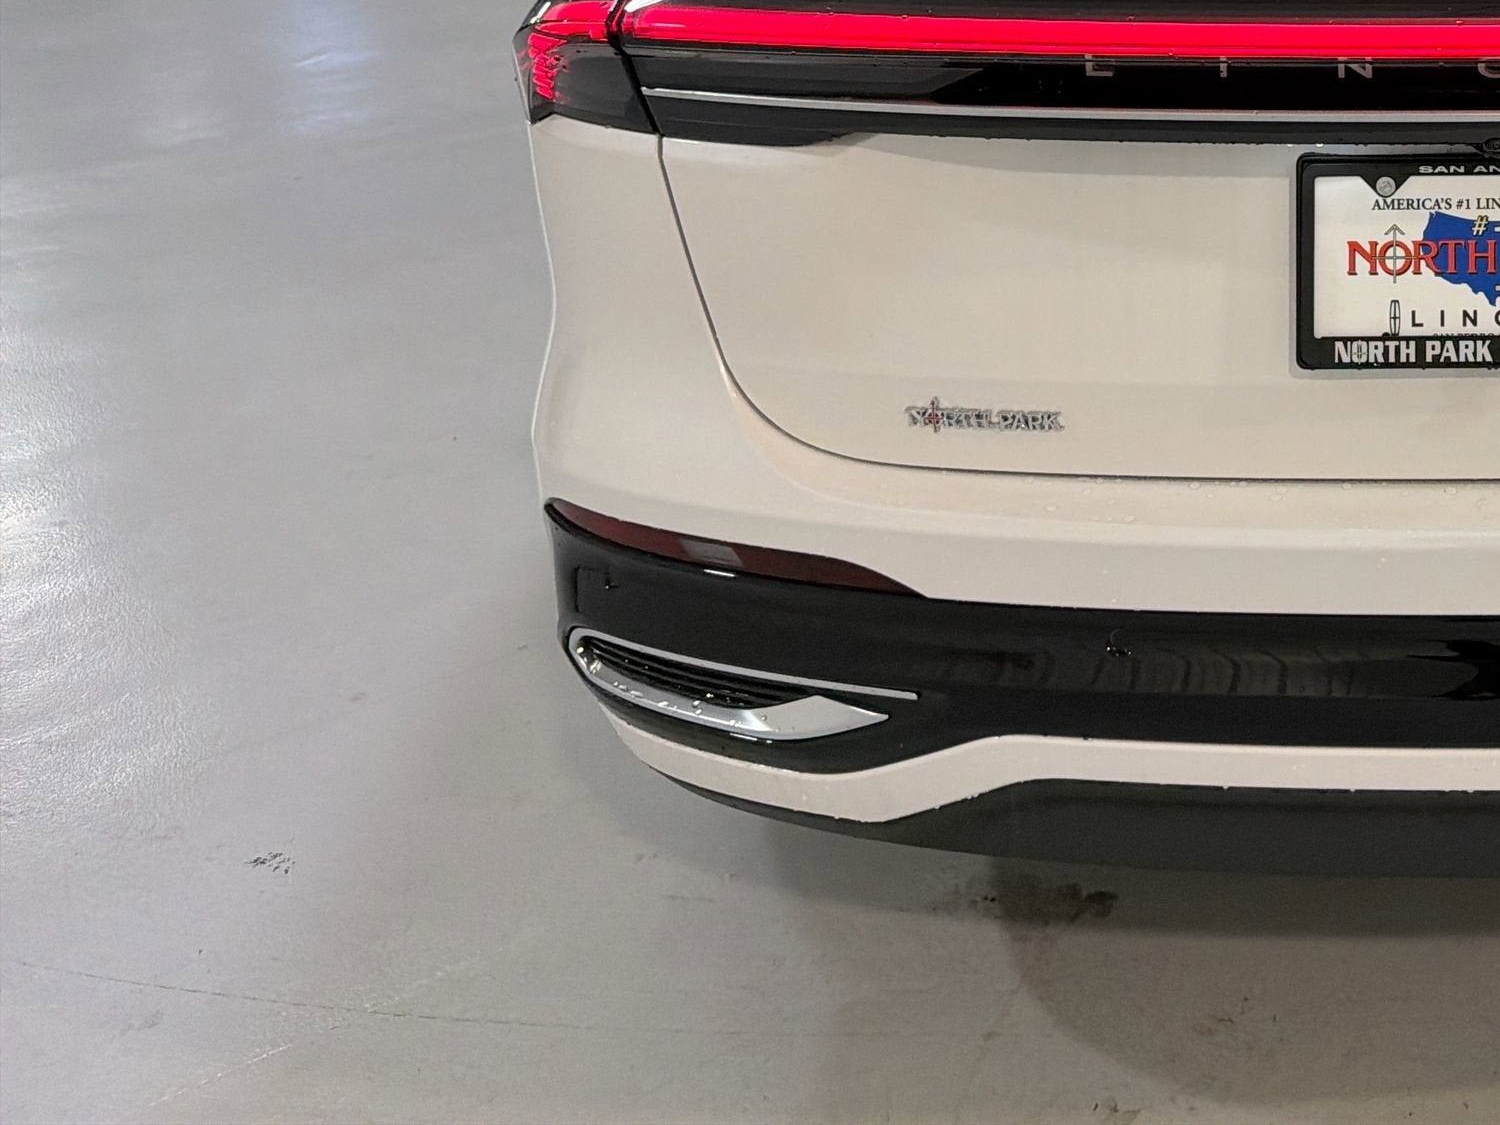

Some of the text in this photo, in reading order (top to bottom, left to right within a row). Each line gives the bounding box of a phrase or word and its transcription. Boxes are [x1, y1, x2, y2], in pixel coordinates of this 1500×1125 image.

[1418, 165, 1464, 173] SAN
[1371, 197, 1453, 211] AMERICA'S
[1455, 197, 1471, 210] #1
[1346, 239, 1497, 275] NORTH
[1335, 340, 1416, 363] NORTH
[1425, 340, 1493, 363] PARK
[997, 410, 1064, 432] PARK
